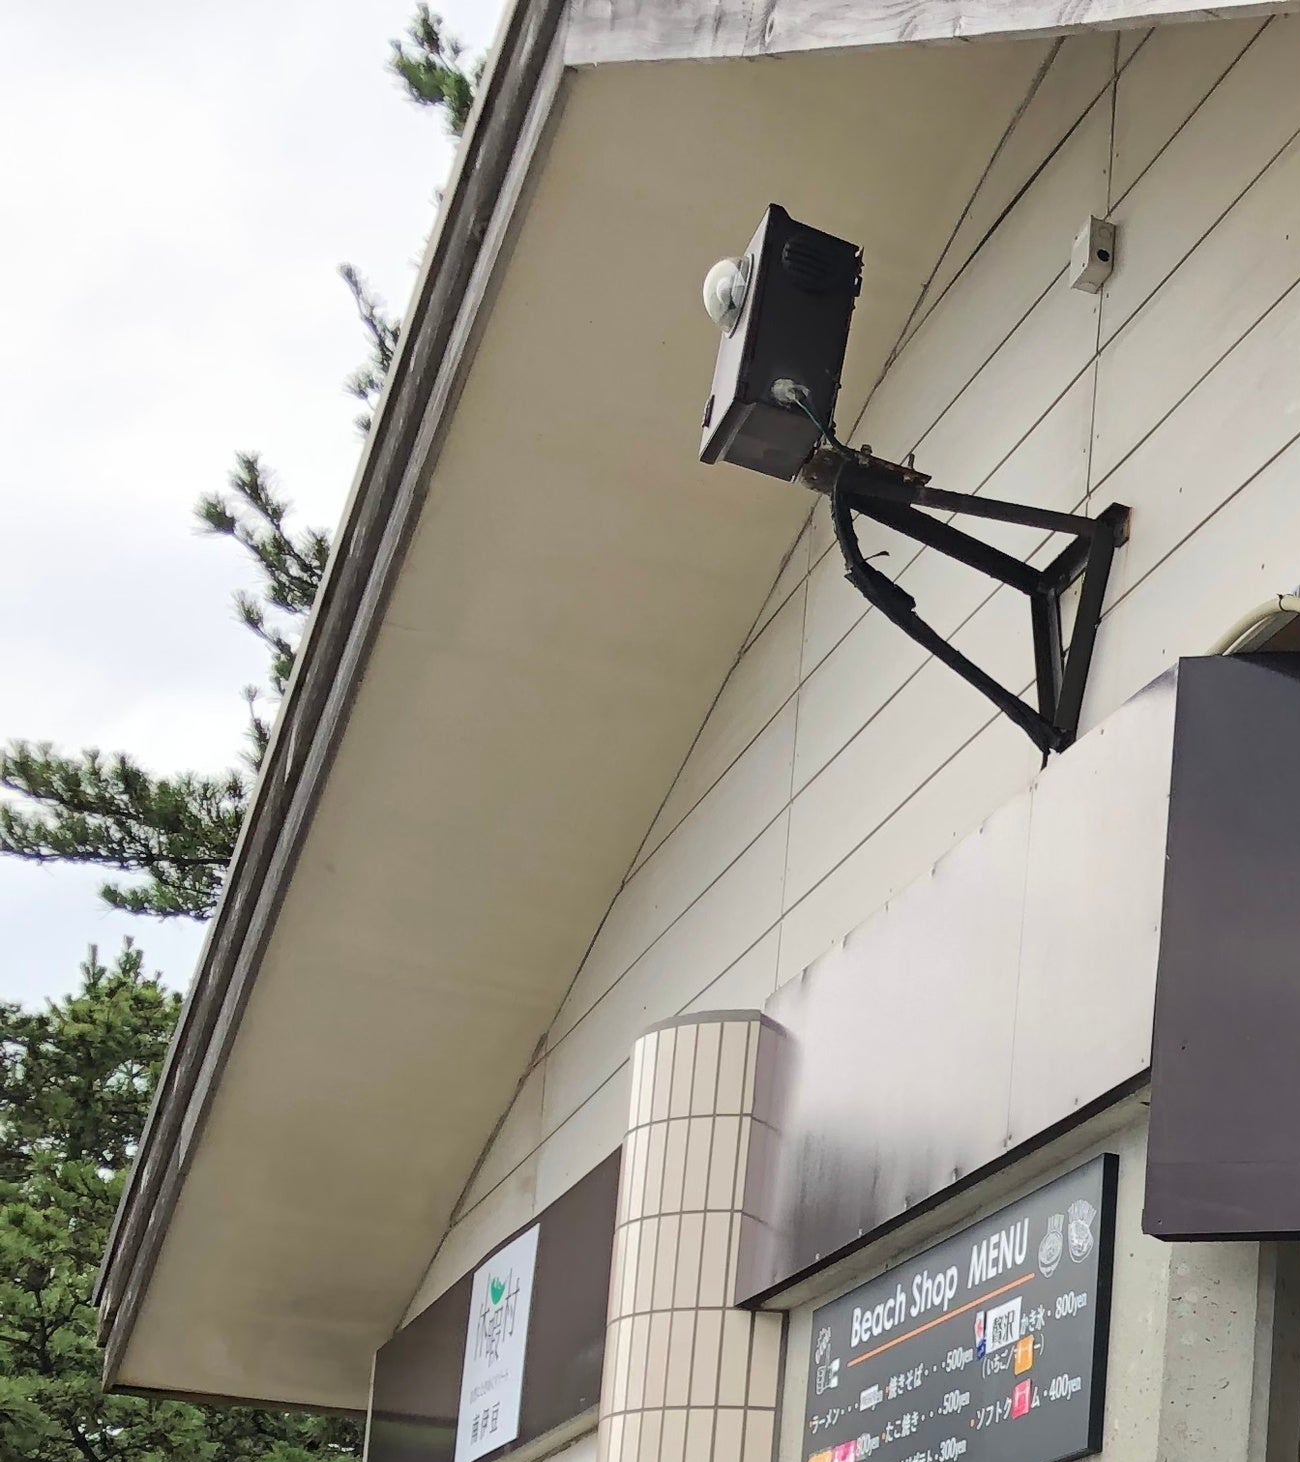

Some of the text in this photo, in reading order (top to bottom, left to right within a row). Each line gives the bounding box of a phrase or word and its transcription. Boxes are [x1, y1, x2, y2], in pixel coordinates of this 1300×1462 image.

[850, 1218, 1030, 1348] Beach Shop MENU
